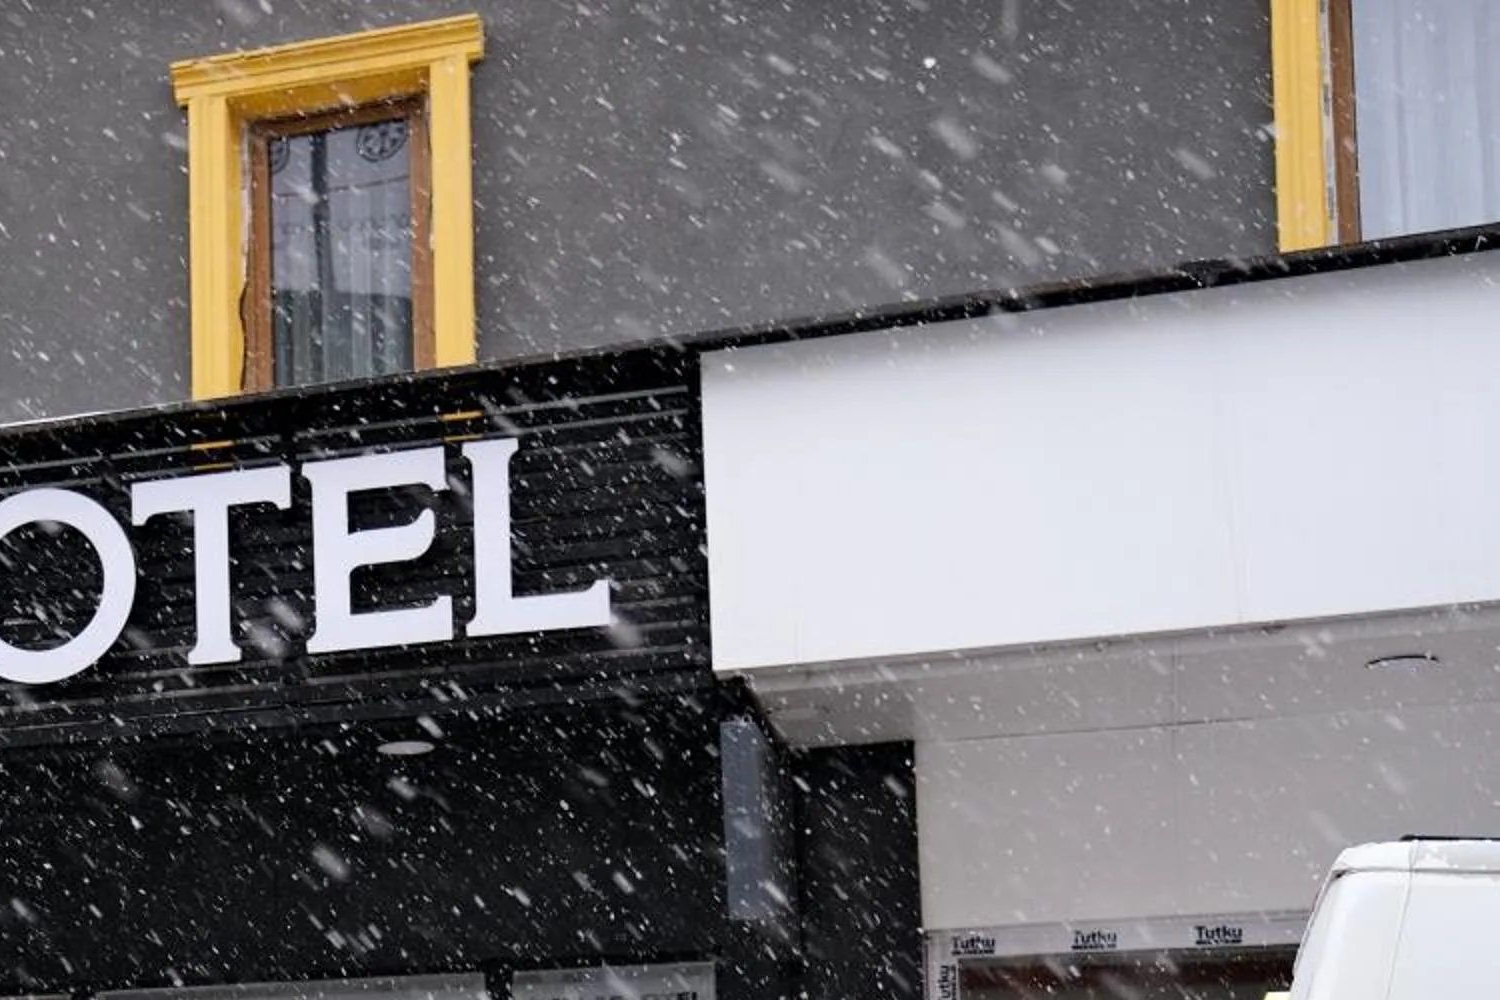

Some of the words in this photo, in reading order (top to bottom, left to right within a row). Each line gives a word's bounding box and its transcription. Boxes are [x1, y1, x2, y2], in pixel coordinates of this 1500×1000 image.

[1072, 930, 1117, 946] Tutku
[1195, 925, 1243, 940] Tutku
[952, 936, 996, 951] Tutku
